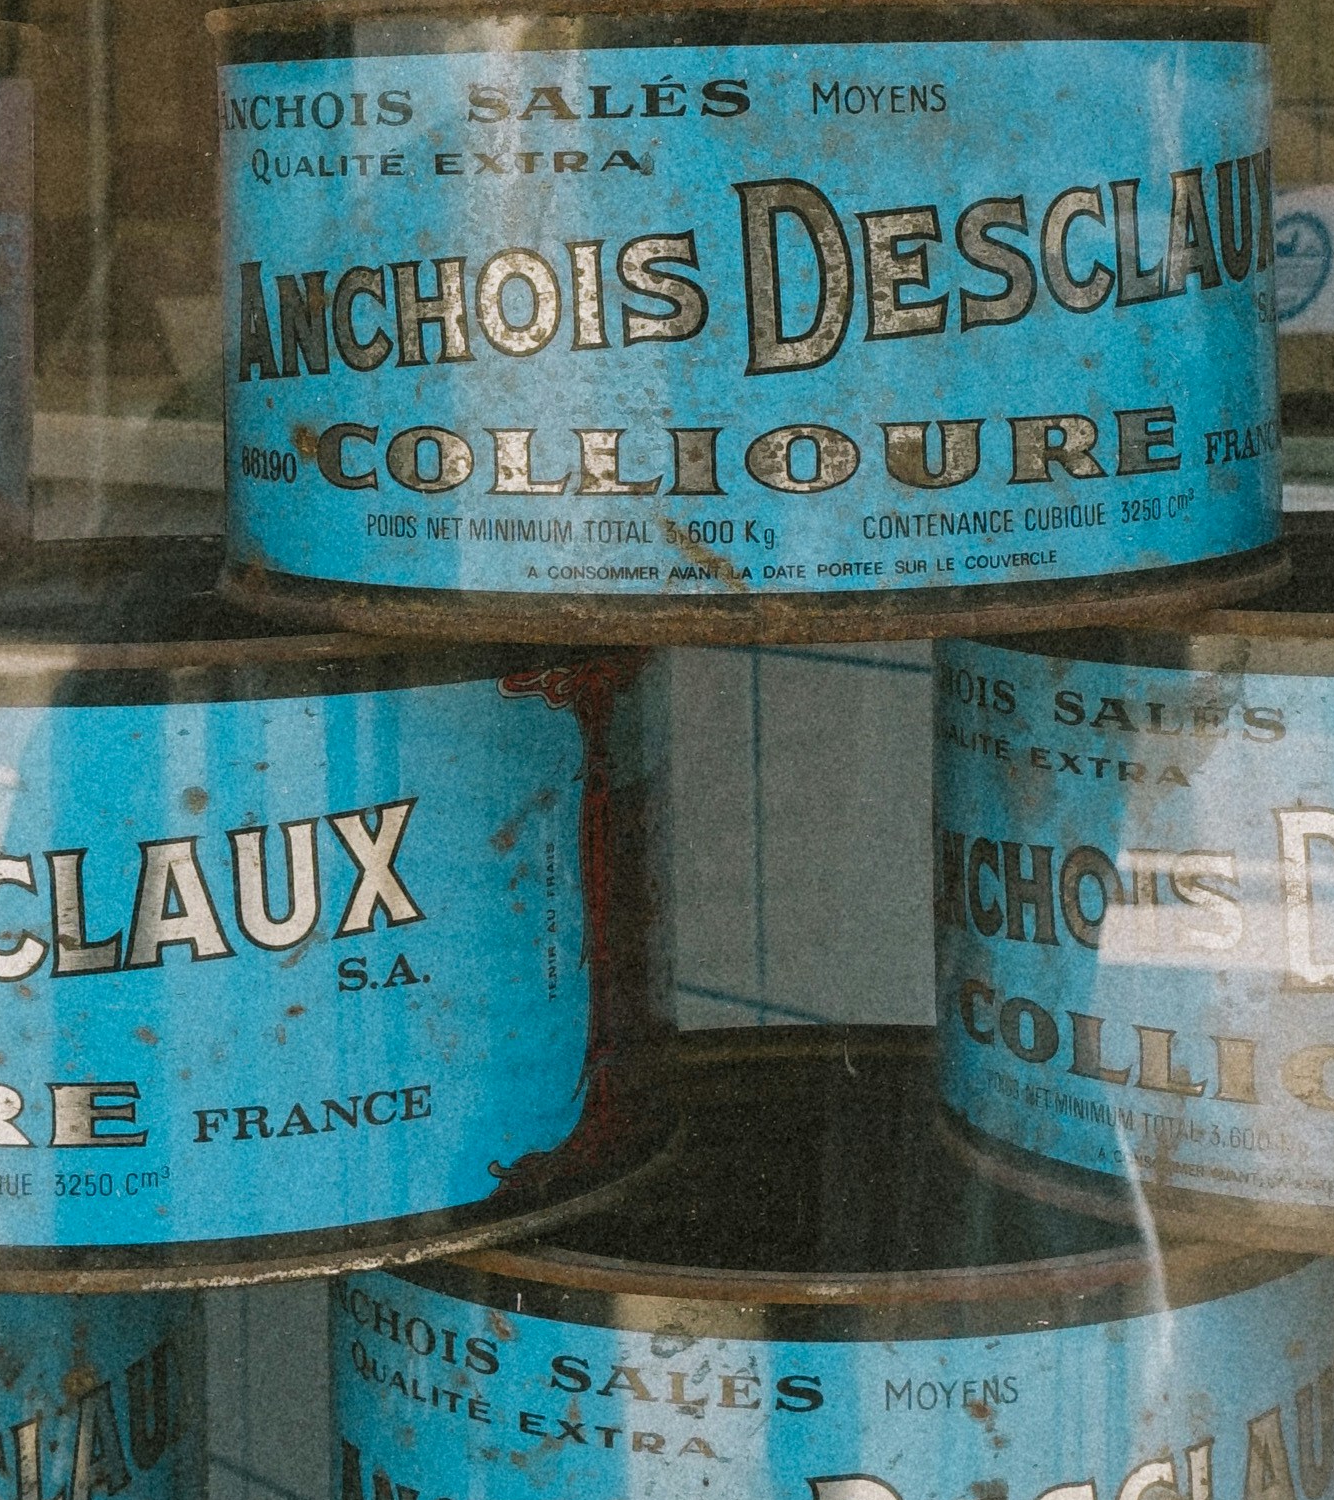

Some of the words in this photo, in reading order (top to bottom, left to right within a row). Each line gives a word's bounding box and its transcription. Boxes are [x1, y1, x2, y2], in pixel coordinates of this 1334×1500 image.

[467, 74, 752, 126] SALÉS
[811, 81, 948, 116] MOYENS
[251, 147, 405, 186] QUALITÉ
[434, 148, 645, 177] EXTRA
[237, 228, 710, 384] ANCHOIS
[315, 406, 1183, 496] COLLIOURE
[367, 513, 417, 539] POIDS
[426, 515, 464, 541] NET
[469, 517, 573, 544] MINIMUM
[586, 519, 653, 545] TOTAL
[744, 520, 776, 551] Kg
[862, 507, 1014, 541] CONTENANCE
[1024, 500, 1106, 533] CUBIQUE
[1120, 497, 1163, 523] 3250
[526, 567, 538, 580] A
[547, 565, 660, 581] CONSOMMER
[668, 566, 722, 582] AVANT
[762, 565, 809, 581] DATE
[816, 561, 884, 578] PORTEE
[894, 557, 928, 574] SUR
[936, 555, 956, 572] LE
[965, 550, 1058, 571] COUVERCLE
[1029, 746, 1192, 788] EXTRA
[336, 956, 431, 995] S.A.
[192, 1083, 432, 1144] FRANCE
[1054, 1087, 1134, 1132] MINIMUM
[53, 1172, 113, 1198] 3250
[351, 1339, 492, 1425] QUALITÉ
[519, 1410, 718, 1459] EXTRA
[883, 1373, 1021, 1411] MOYENS
